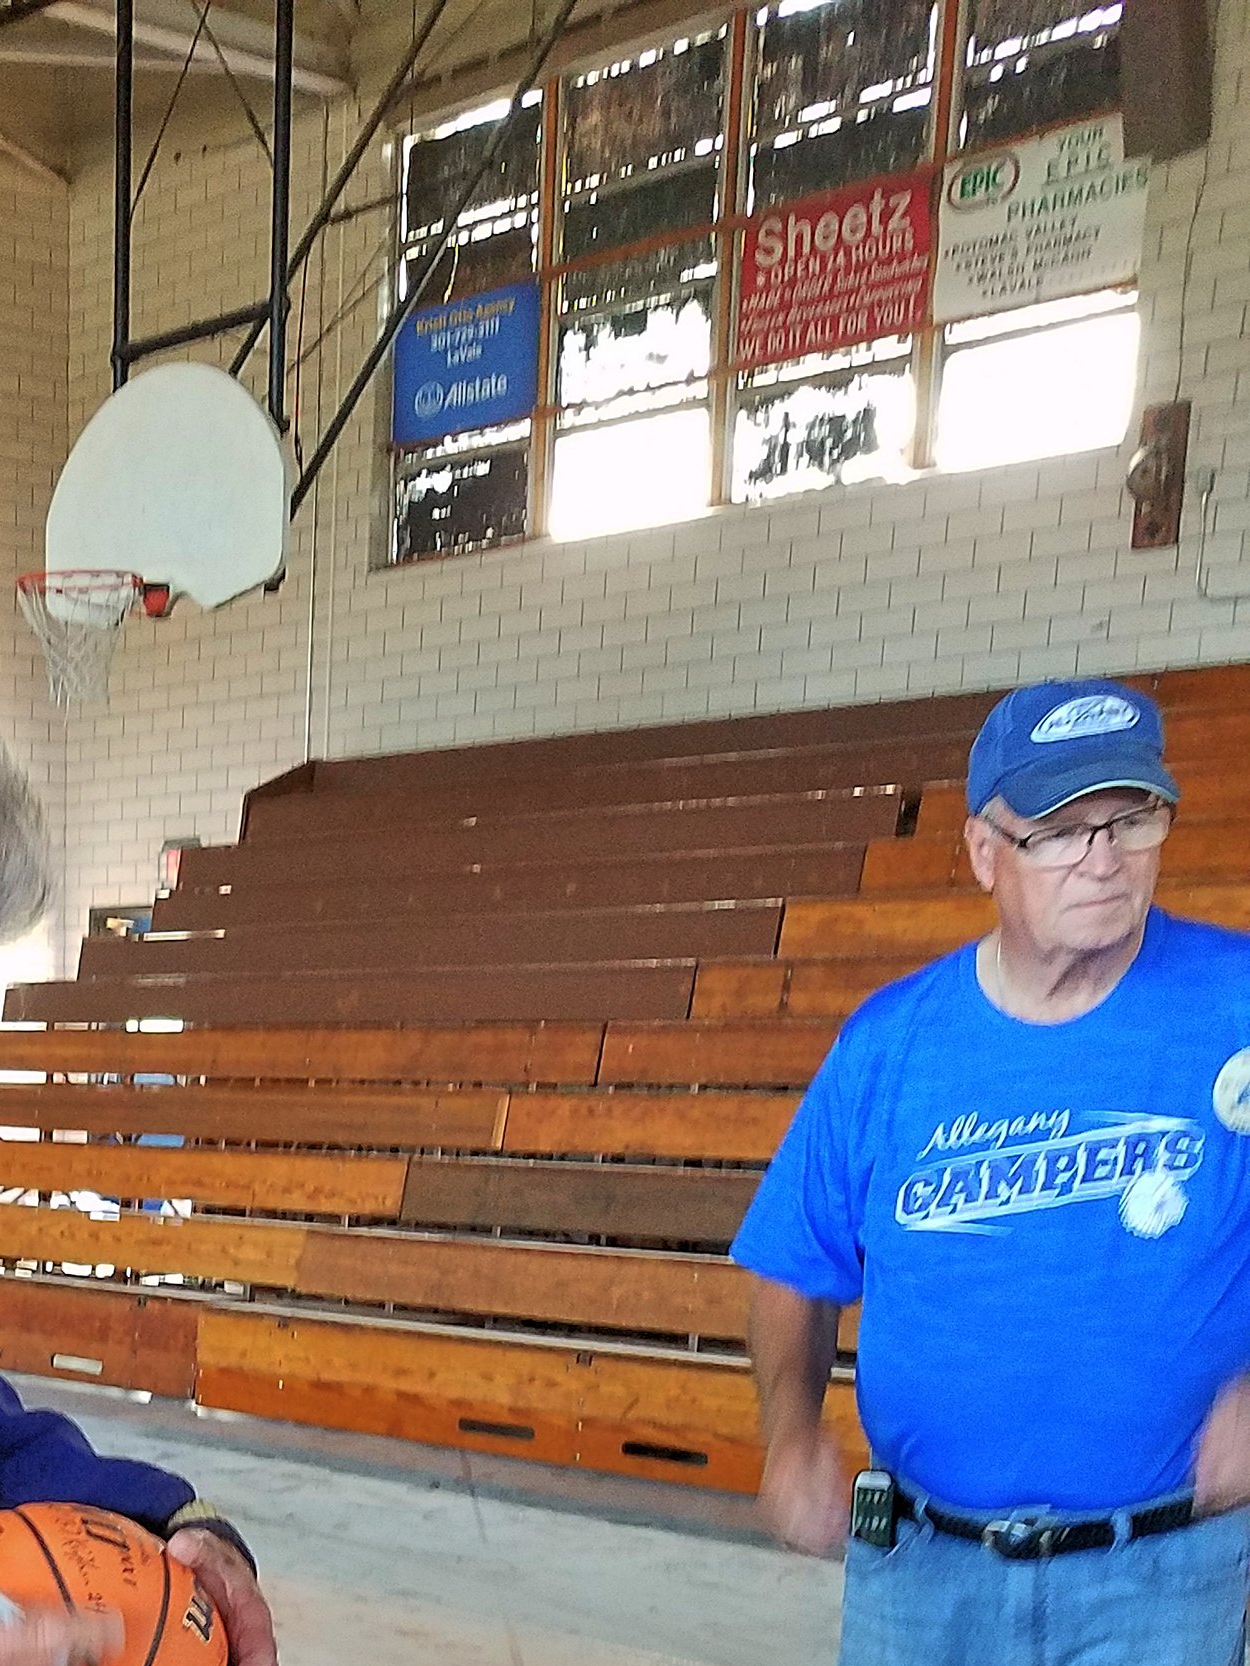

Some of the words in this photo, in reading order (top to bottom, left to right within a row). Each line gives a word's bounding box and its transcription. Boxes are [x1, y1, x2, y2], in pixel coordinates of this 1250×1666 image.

[959, 160, 1006, 200] EPIC
[1007, 166, 1149, 223] PHARMACIES
[755, 188, 912, 267] Sheetz
[1025, 214, 1078, 241] VALLEY
[771, 253, 821, 287] OPEN
[852, 226, 914, 265] HOURS
[805, 317, 834, 349] ALL
[838, 308, 868, 340] FOR
[444, 372, 509, 410] Allstate
[915, 1108, 1071, 1161] Allegany
[899, 1130, 1206, 1219] CAMPERS
